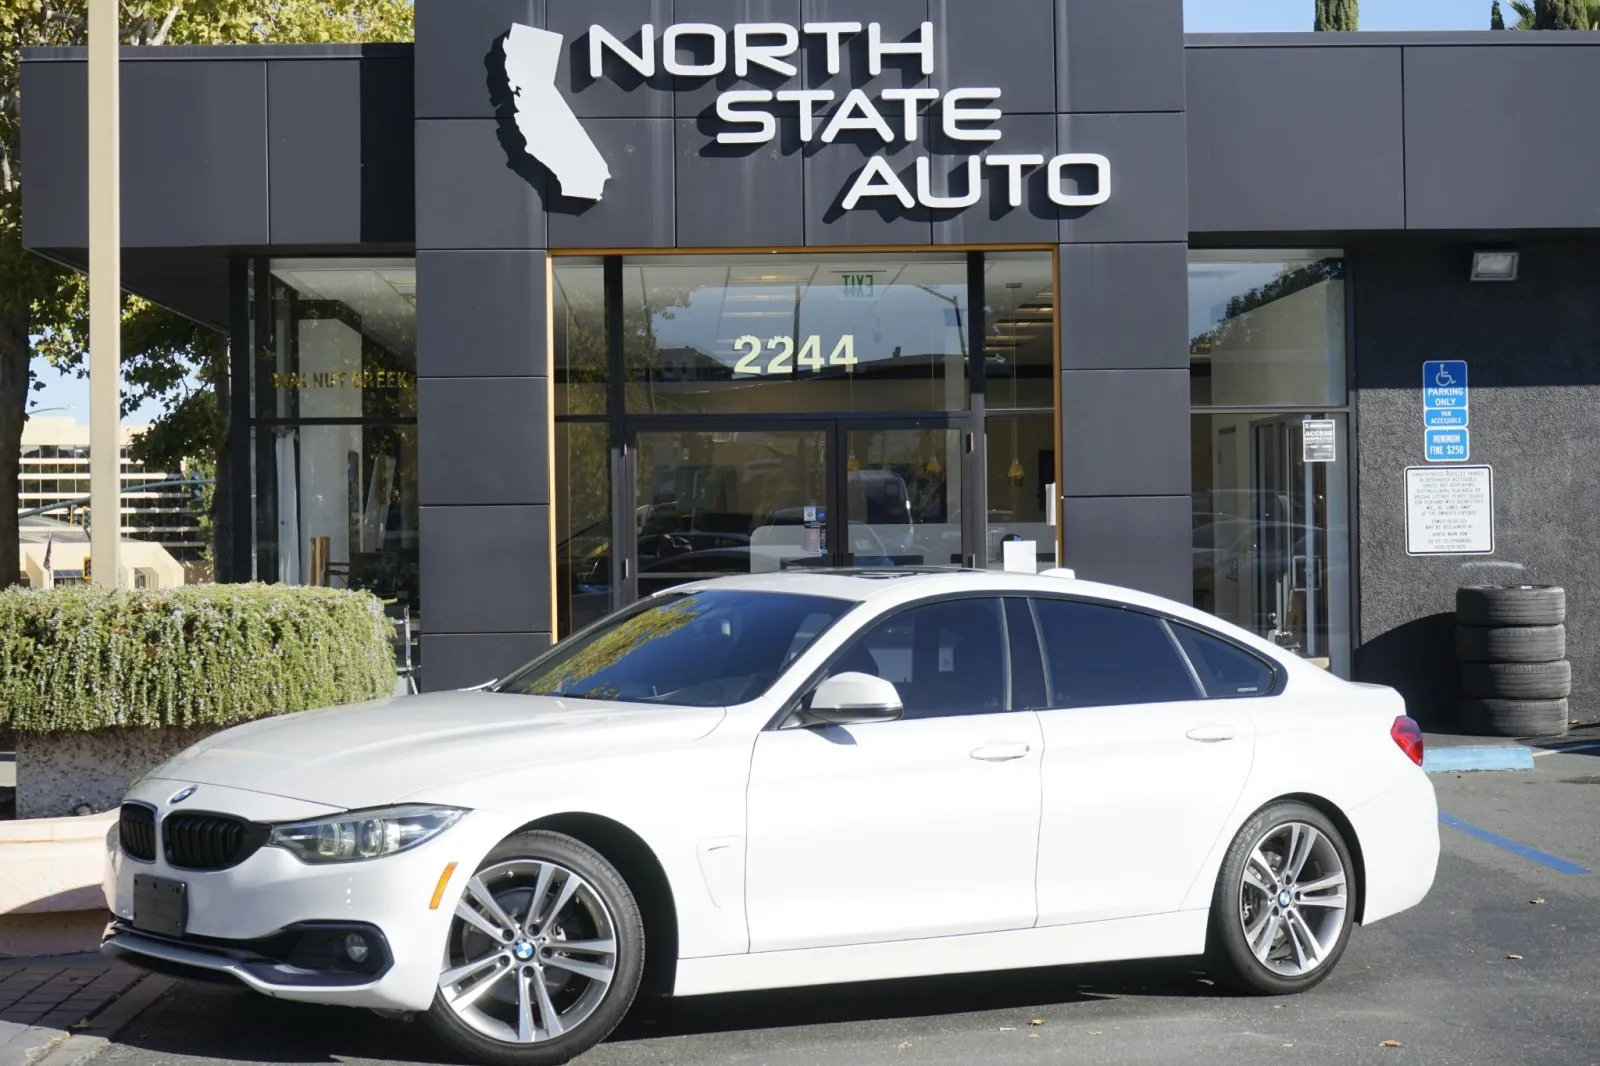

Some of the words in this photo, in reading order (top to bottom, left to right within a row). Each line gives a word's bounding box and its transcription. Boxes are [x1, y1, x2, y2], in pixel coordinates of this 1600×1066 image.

[589, 21, 934, 78] NORTH
[715, 87, 1002, 144] STATE
[841, 153, 1112, 210] AUTO
[733, 334, 858, 374] 2244
[272, 372, 347, 389] WALNUT
[352, 370, 408, 388] CREEK
[1428, 387, 1463, 396] PARKING
[1435, 398, 1456, 406] ONLY
[1431, 417, 1462, 425] ACCESSIBLE
[1433, 434, 1460, 443] MINIMUM
[1430, 445, 1444, 455] FINE
[1447, 445, 1464, 455] $250
